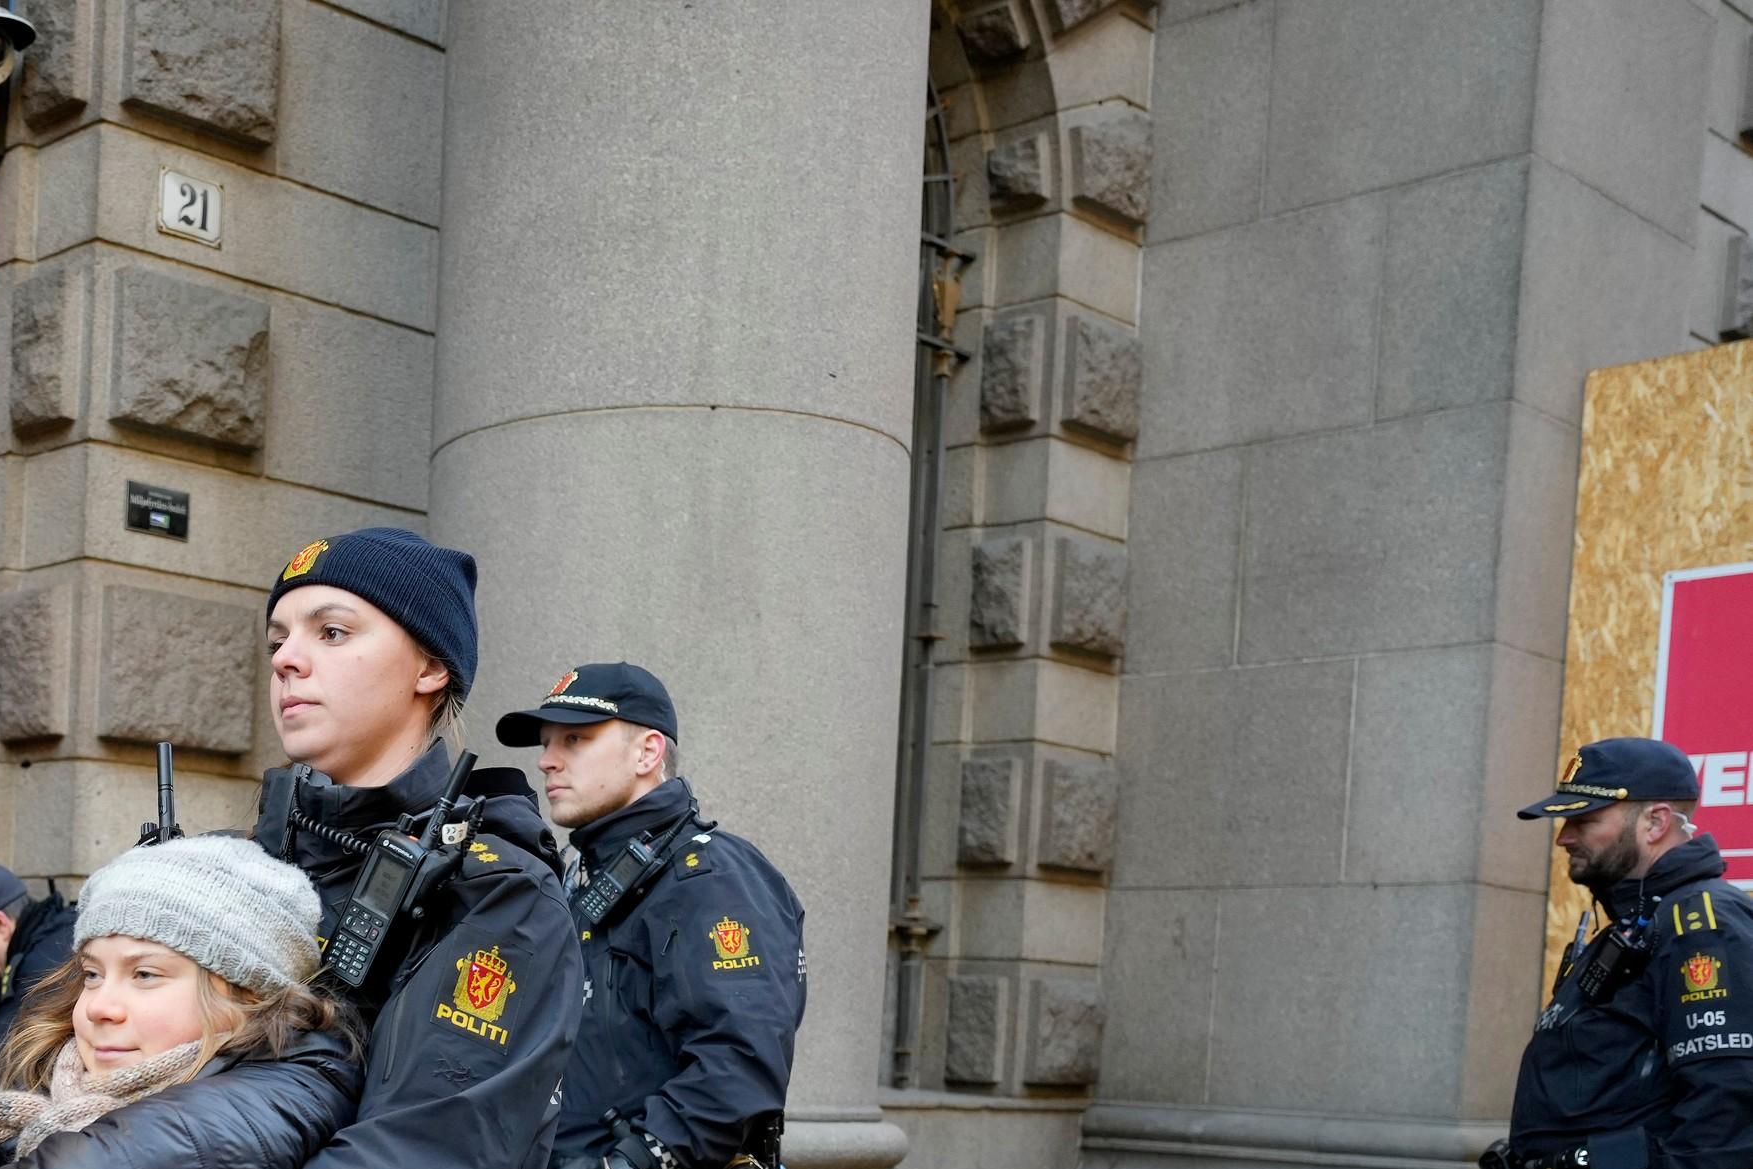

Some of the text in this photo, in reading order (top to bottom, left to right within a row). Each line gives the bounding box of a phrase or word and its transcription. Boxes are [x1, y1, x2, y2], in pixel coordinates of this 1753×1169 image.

[178, 183, 208, 231] 21
[712, 956, 760, 970] POLITI
[1681, 988, 1727, 1003] POLITI
[436, 1003, 509, 1045] POLITI
[1686, 1010, 1726, 1030] U-05
